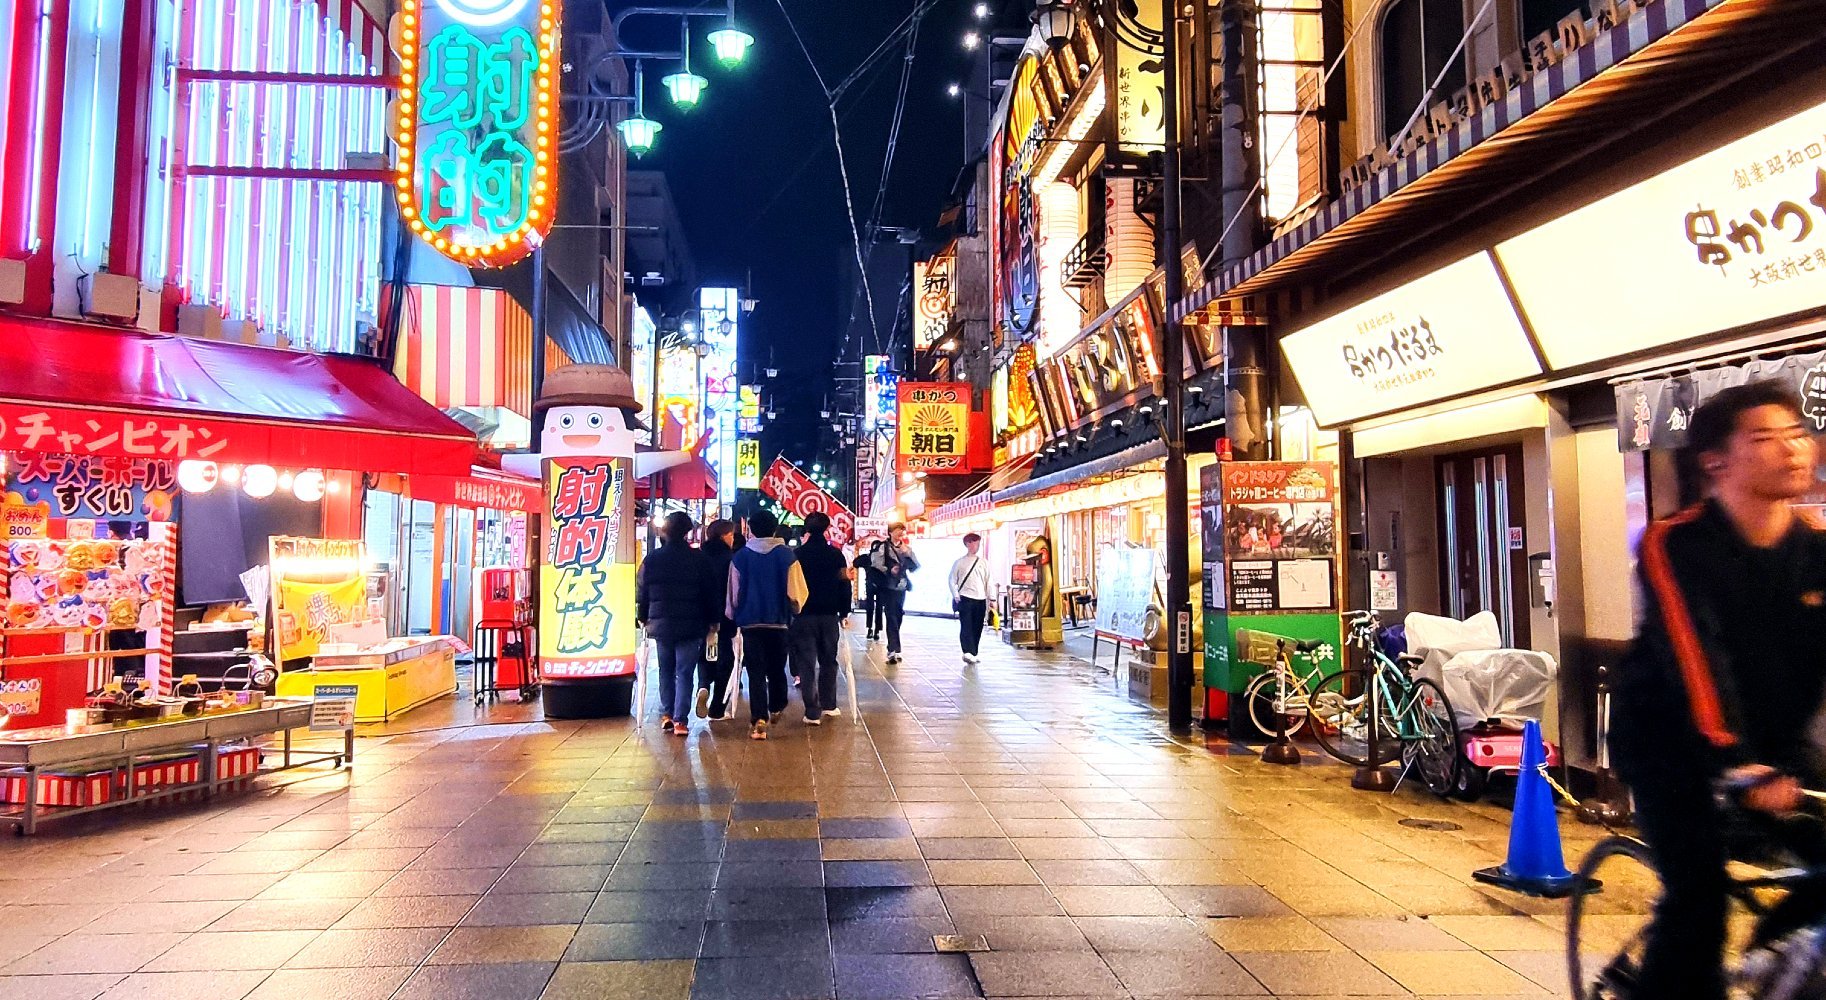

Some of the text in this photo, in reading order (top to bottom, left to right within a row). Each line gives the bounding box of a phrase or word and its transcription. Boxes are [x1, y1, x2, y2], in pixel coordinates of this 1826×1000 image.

[421, 24, 538, 234] 射的
[1733, 133, 1826, 190] 創業昭和四
[1342, 314, 1443, 385] 串かつだるま
[912, 389, 957, 402] 串かつ
[15, 412, 228, 458] チャンピオン
[911, 433, 955, 454] 朝日
[14, 452, 175, 491] スーパーボール
[739, 443, 758, 478] 射的
[908, 457, 960, 469] ホルモン
[54, 482, 133, 515] すくい
[495, 484, 526, 509] チャンピオン
[553, 464, 612, 653] 射的体験
[569, 658, 626, 676] チャンピオン
